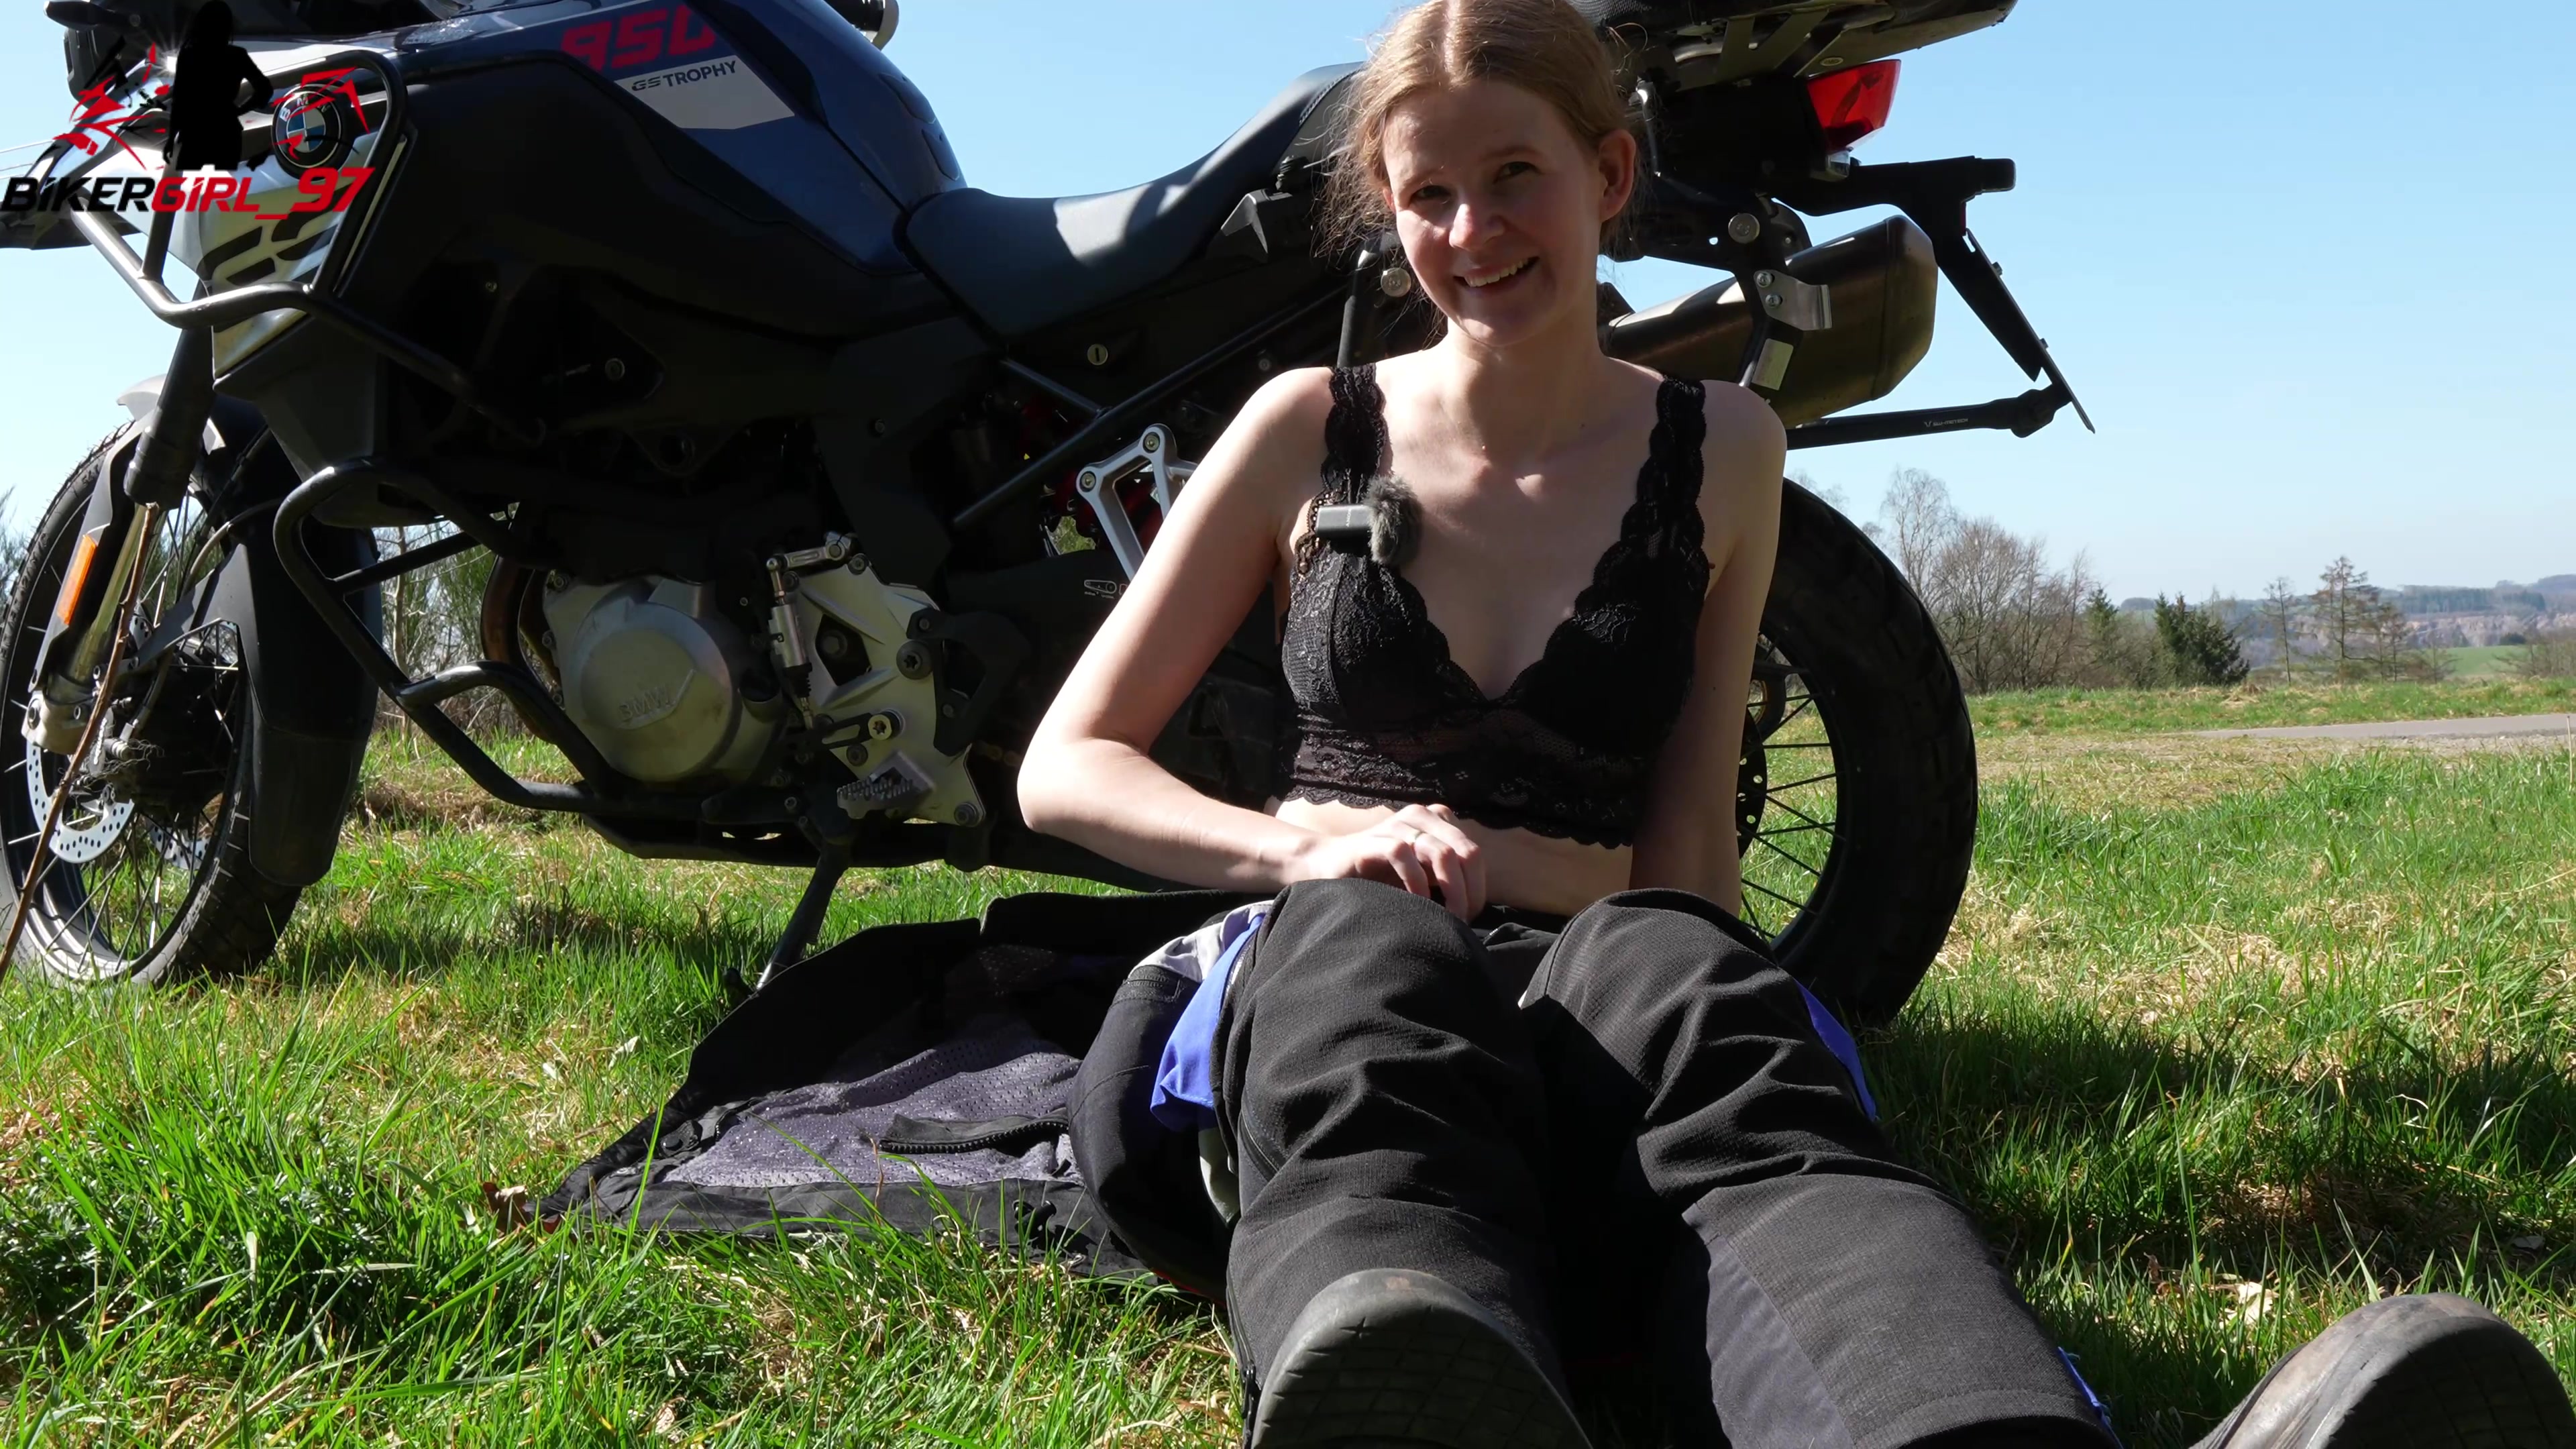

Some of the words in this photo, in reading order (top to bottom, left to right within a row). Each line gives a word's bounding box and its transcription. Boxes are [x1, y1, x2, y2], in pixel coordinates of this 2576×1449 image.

[632, 76, 661, 91] GS
[663, 60, 736, 87] TROPHY
[619, 685, 673, 722] BMW
